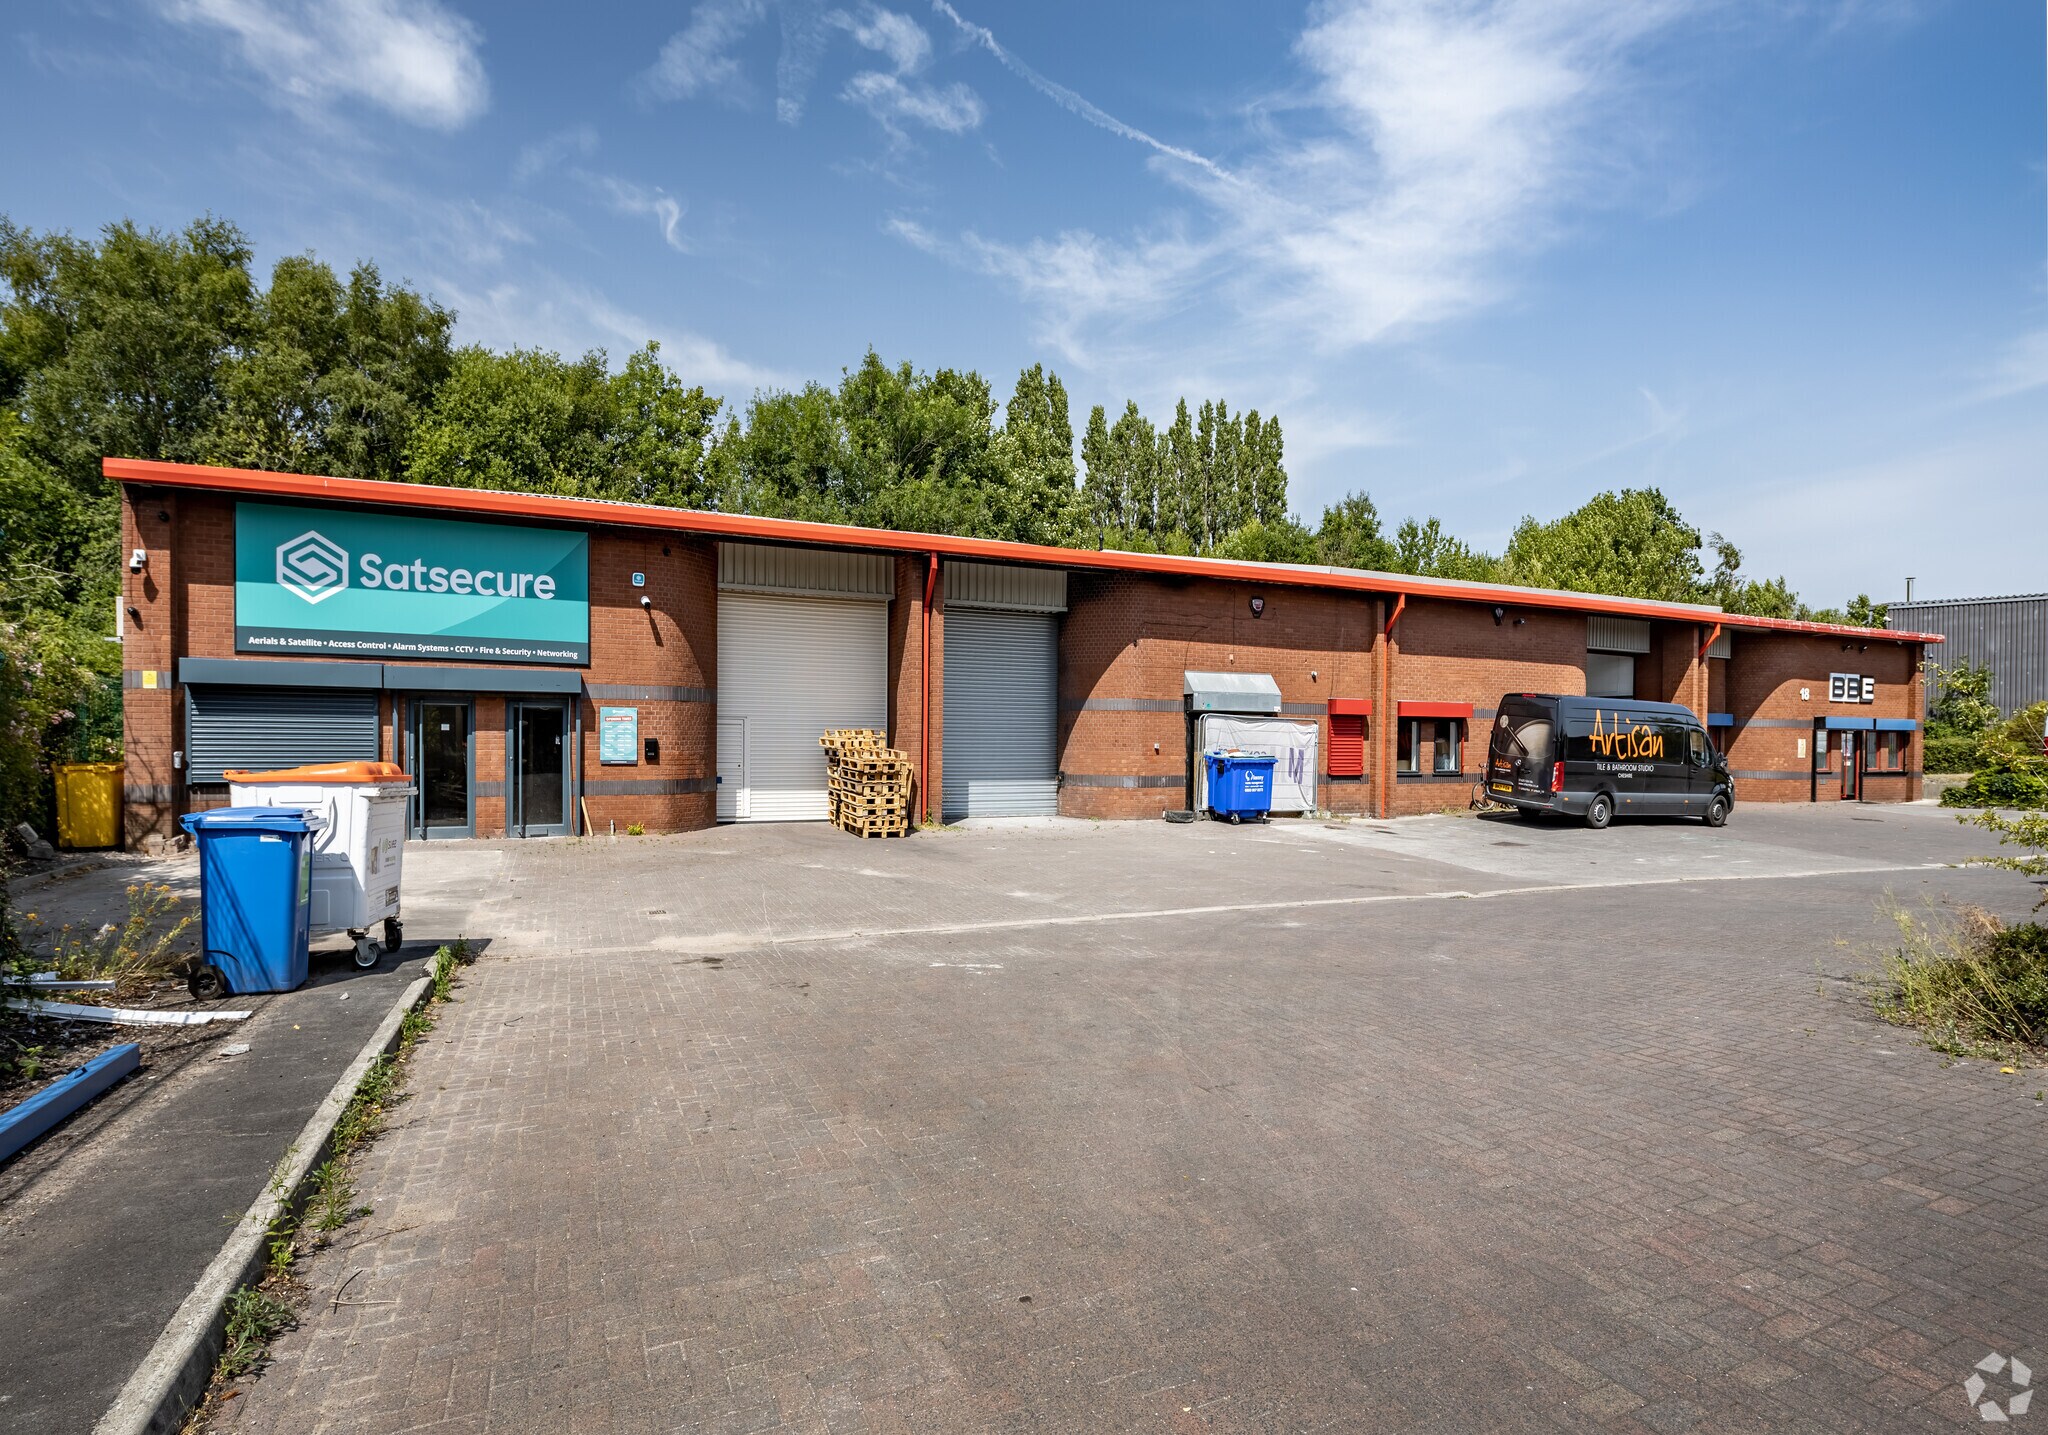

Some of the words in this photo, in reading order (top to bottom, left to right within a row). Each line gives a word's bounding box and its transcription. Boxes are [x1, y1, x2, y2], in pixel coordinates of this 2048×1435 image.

[360, 553, 556, 600] Satsecure
[248, 636, 278, 645] Aerials
[279, 637, 287, 645] &
[287, 637, 323, 647] Satellite
[328, 639, 356, 648] Access
[357, 640, 387, 650] Control
[392, 642, 417, 651] Alarm
[417, 643, 449, 653] Systems
[455, 645, 474, 654] CCTV
[479, 646, 494, 655] Fire
[494, 646, 501, 655] &
[502, 647, 532, 658] Security
[537, 649, 578, 660] Networking
[1799, 688, 1810, 700] 18
[1830, 674, 1875, 701] BBE
[1588, 709, 1664, 760] Artisan
[1596, 763, 1606, 771] TILE
[1611, 764, 1637, 772] BATHROOM
